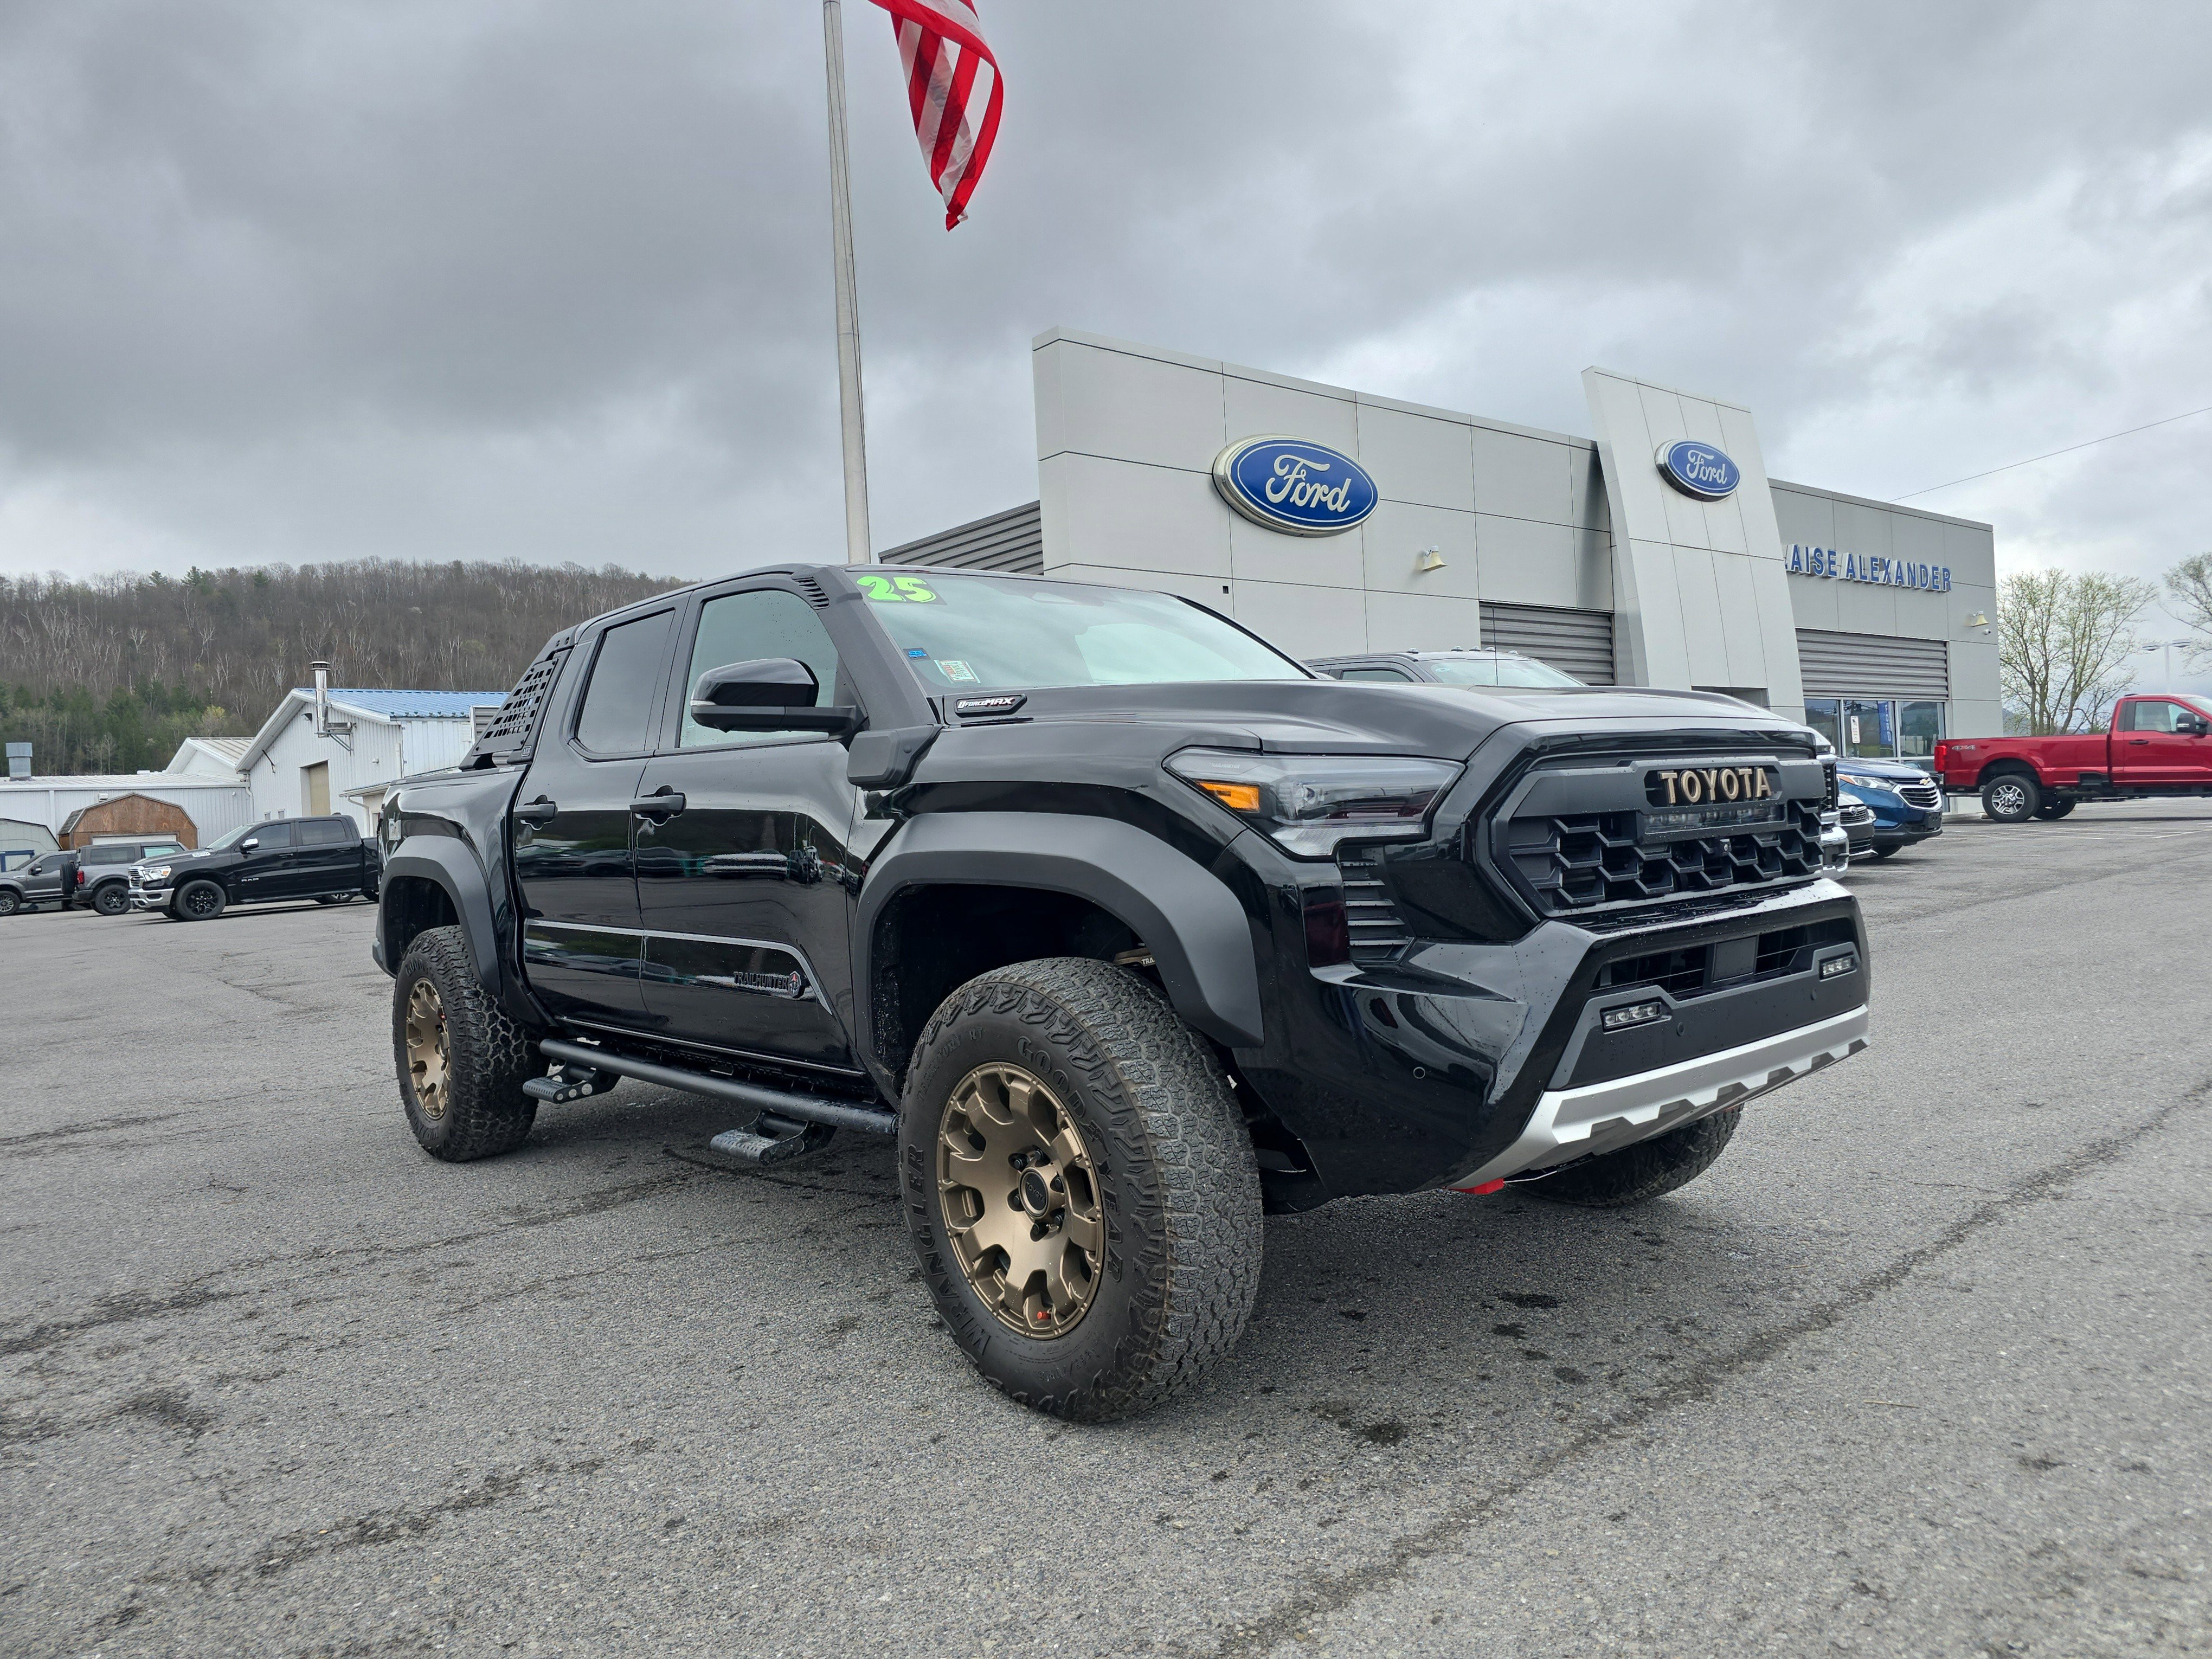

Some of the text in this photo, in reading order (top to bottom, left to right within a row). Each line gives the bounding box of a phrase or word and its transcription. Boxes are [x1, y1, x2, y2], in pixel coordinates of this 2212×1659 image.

[1265, 454, 1352, 512] Ford
[1686, 449, 1727, 485] Ford
[1785, 544, 1952, 592] AISE ALEXANDER
[857, 576, 936, 603] 25
[1660, 768, 1772, 804] TOYOTA
[734, 971, 789, 990] TRAILHUNTER
[1017, 1036, 1123, 1282] GOODYEAR
[908, 1144, 991, 1355] WRANGLER
